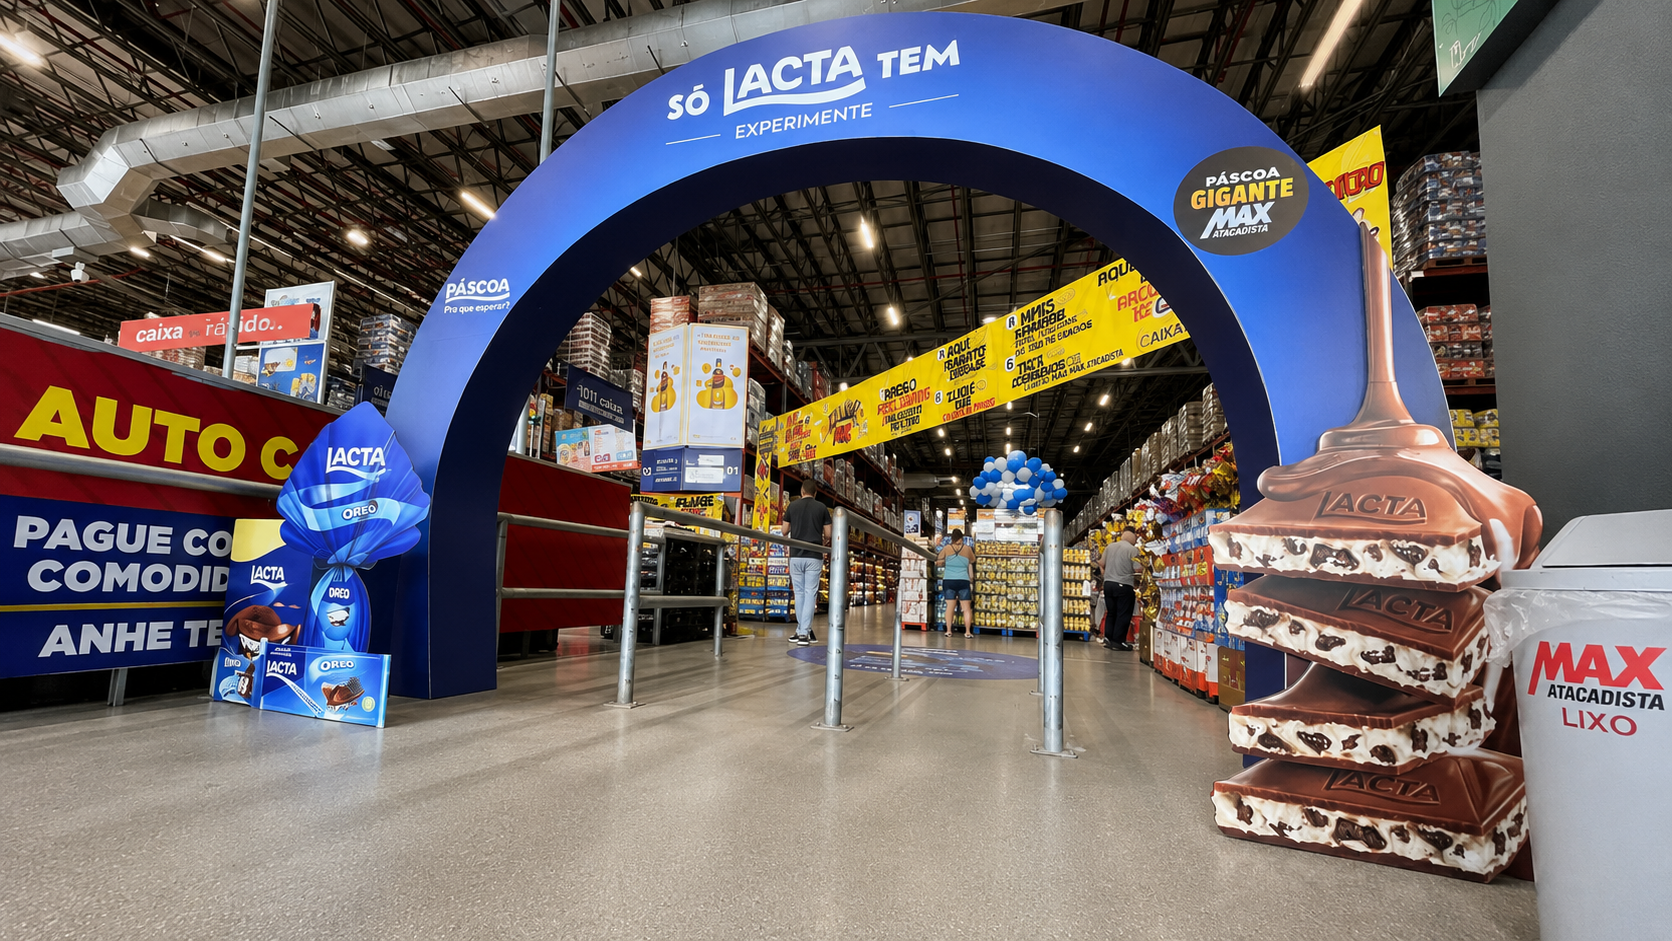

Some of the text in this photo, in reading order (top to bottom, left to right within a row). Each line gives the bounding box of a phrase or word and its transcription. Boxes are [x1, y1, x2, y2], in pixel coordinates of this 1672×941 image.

[723, 46, 867, 117] LACTA
[876, 40, 960, 79] TEM
[735, 102, 873, 139] EXPERIMENTE
[1205, 166, 1281, 188] PÁSCOA
[1191, 177, 1294, 211] GIGANTE
[1200, 201, 1275, 239] MAX
[1212, 224, 1269, 238] ATACADISTA
[445, 277, 510, 303] PÁSCOA
[459, 307, 474, 315] que
[136, 323, 183, 343] caixa
[13, 385, 246, 472] AUTO
[326, 447, 386, 477] LACTA
[342, 504, 377, 520] OREO
[1315, 490, 1428, 525] LACTA
[13, 515, 173, 555] PAGUE
[250, 565, 288, 589] LACTA
[1336, 585, 1455, 634] LACTA
[38, 619, 174, 658] ANHE
[266, 660, 297, 677] LACTA
[320, 660, 354, 670] OREO
[1527, 641, 1667, 696] MAX
[1547, 684, 1665, 711] ATACADISTA
[1561, 707, 1637, 736] LIXO
[1321, 769, 1441, 805] LACTA
